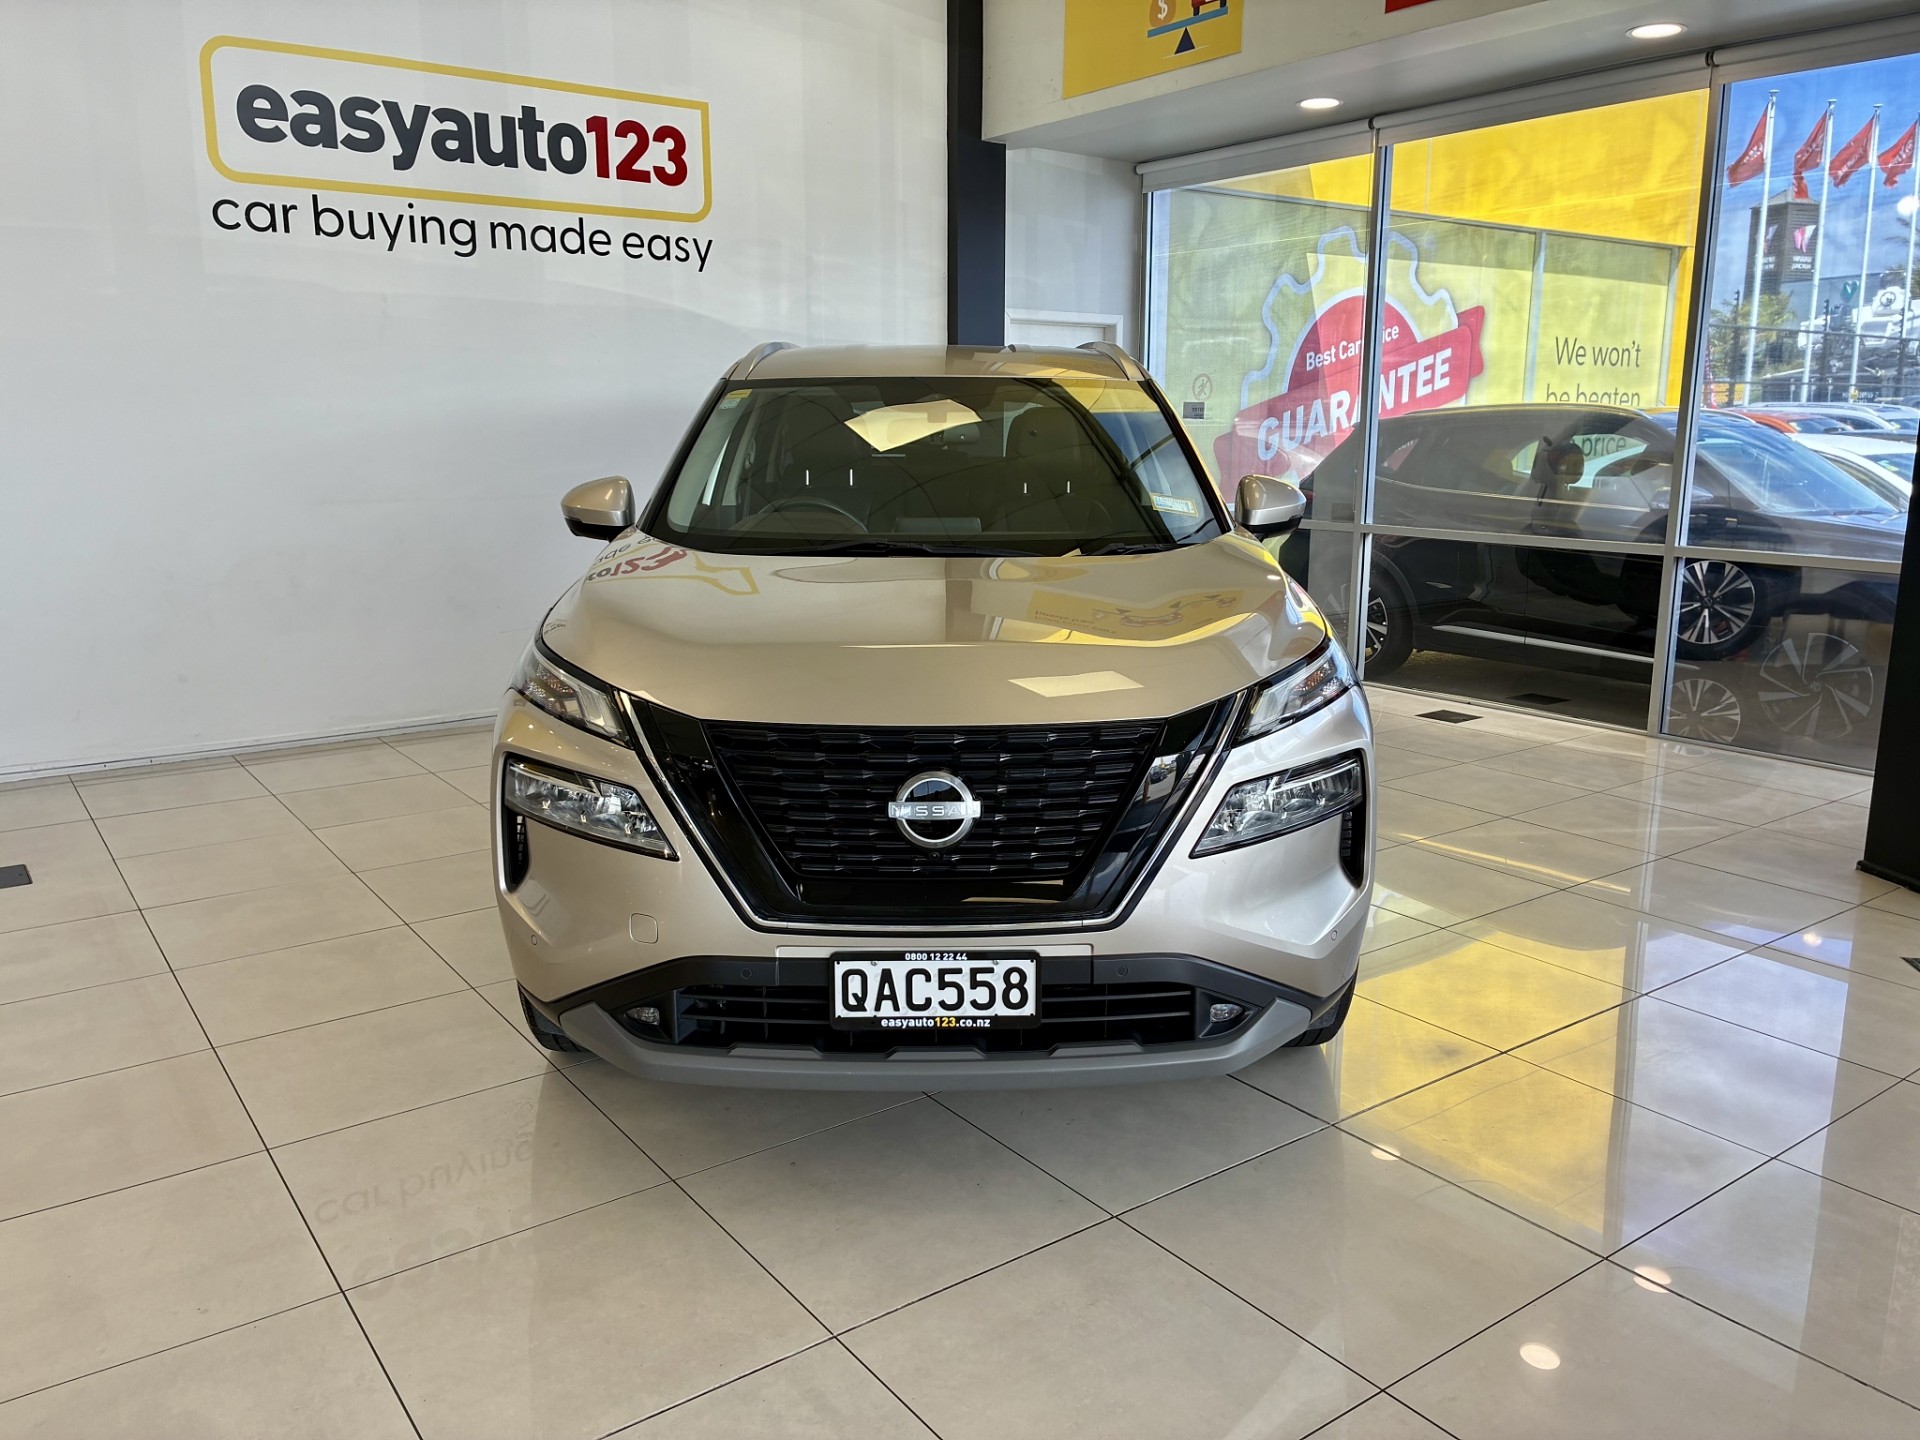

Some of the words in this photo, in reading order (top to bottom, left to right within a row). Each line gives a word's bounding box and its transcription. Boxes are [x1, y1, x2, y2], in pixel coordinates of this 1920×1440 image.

[235, 83, 688, 188] easyauto123
[211, 198, 298, 235] car
[312, 194, 477, 258] buying
[489, 217, 612, 257] made
[621, 231, 713, 272] easy
[1306, 345, 1336, 372] Best
[1338, 340, 1360, 359] Car
[1555, 336, 1586, 366] We
[1592, 340, 1641, 368] won't
[1581, 436, 1627, 457] price
[890, 803, 978, 817] NISSA
[905, 952, 928, 961] 0800
[929, 952, 941, 961] 12
[942, 953, 954, 961] 22
[955, 952, 968, 961] 44
[841, 966, 1029, 1012] QAC558
[881, 1016, 991, 1029] easyauto123.co.nz
